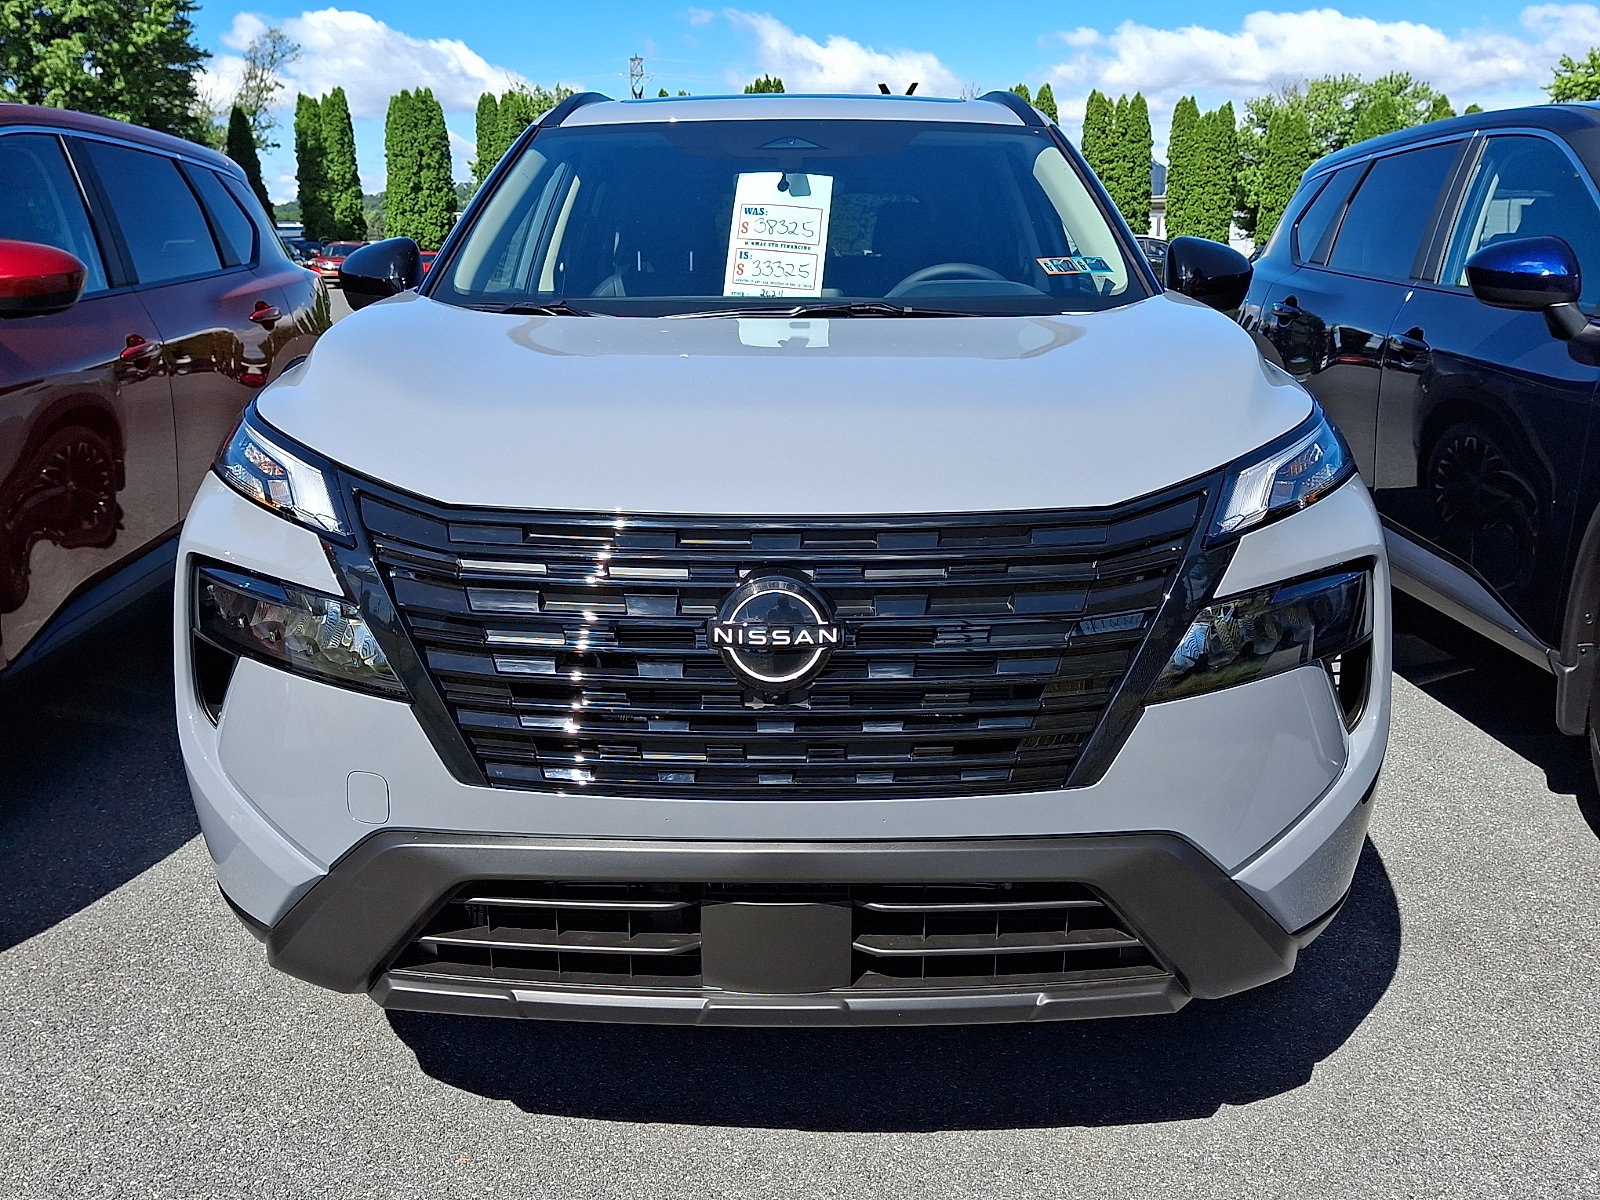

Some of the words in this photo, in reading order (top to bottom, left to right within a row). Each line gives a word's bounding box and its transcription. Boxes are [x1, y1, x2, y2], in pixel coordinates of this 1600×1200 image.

[744, 207, 769, 216] WAS:
[754, 217, 815, 238] 38325
[780, 243, 812, 251] FINANCING
[738, 251, 753, 260] IS:
[751, 259, 810, 279] 33325
[713, 627, 838, 645] NISSAN
